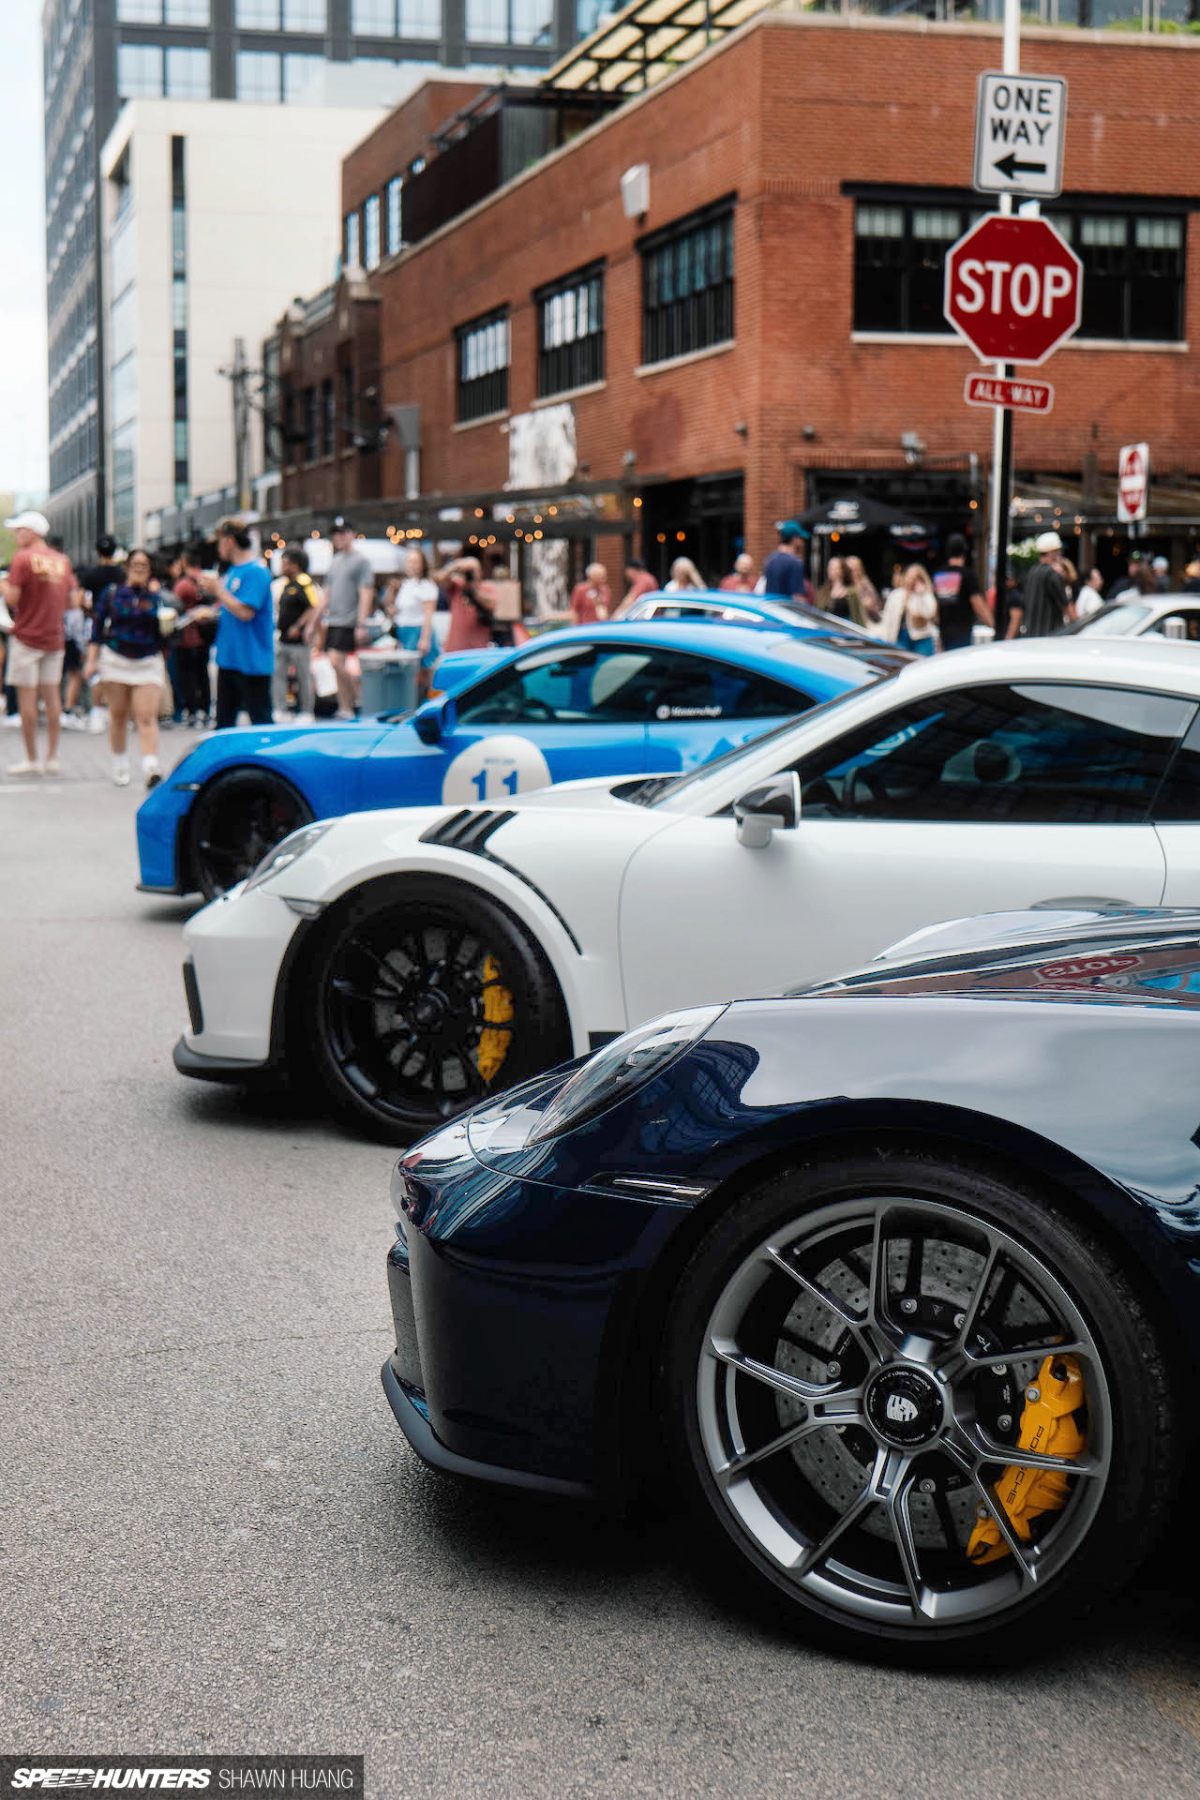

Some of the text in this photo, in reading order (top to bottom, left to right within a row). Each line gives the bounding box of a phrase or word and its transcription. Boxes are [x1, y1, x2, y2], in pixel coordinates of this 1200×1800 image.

[993, 84, 1053, 115] ONE
[990, 117, 1053, 146] WAY
[955, 259, 1073, 318] STOP
[973, 381, 1045, 407] ALL WAY
[471, 769, 518, 801] 11
[1006, 1425, 1045, 1505] POCHE
